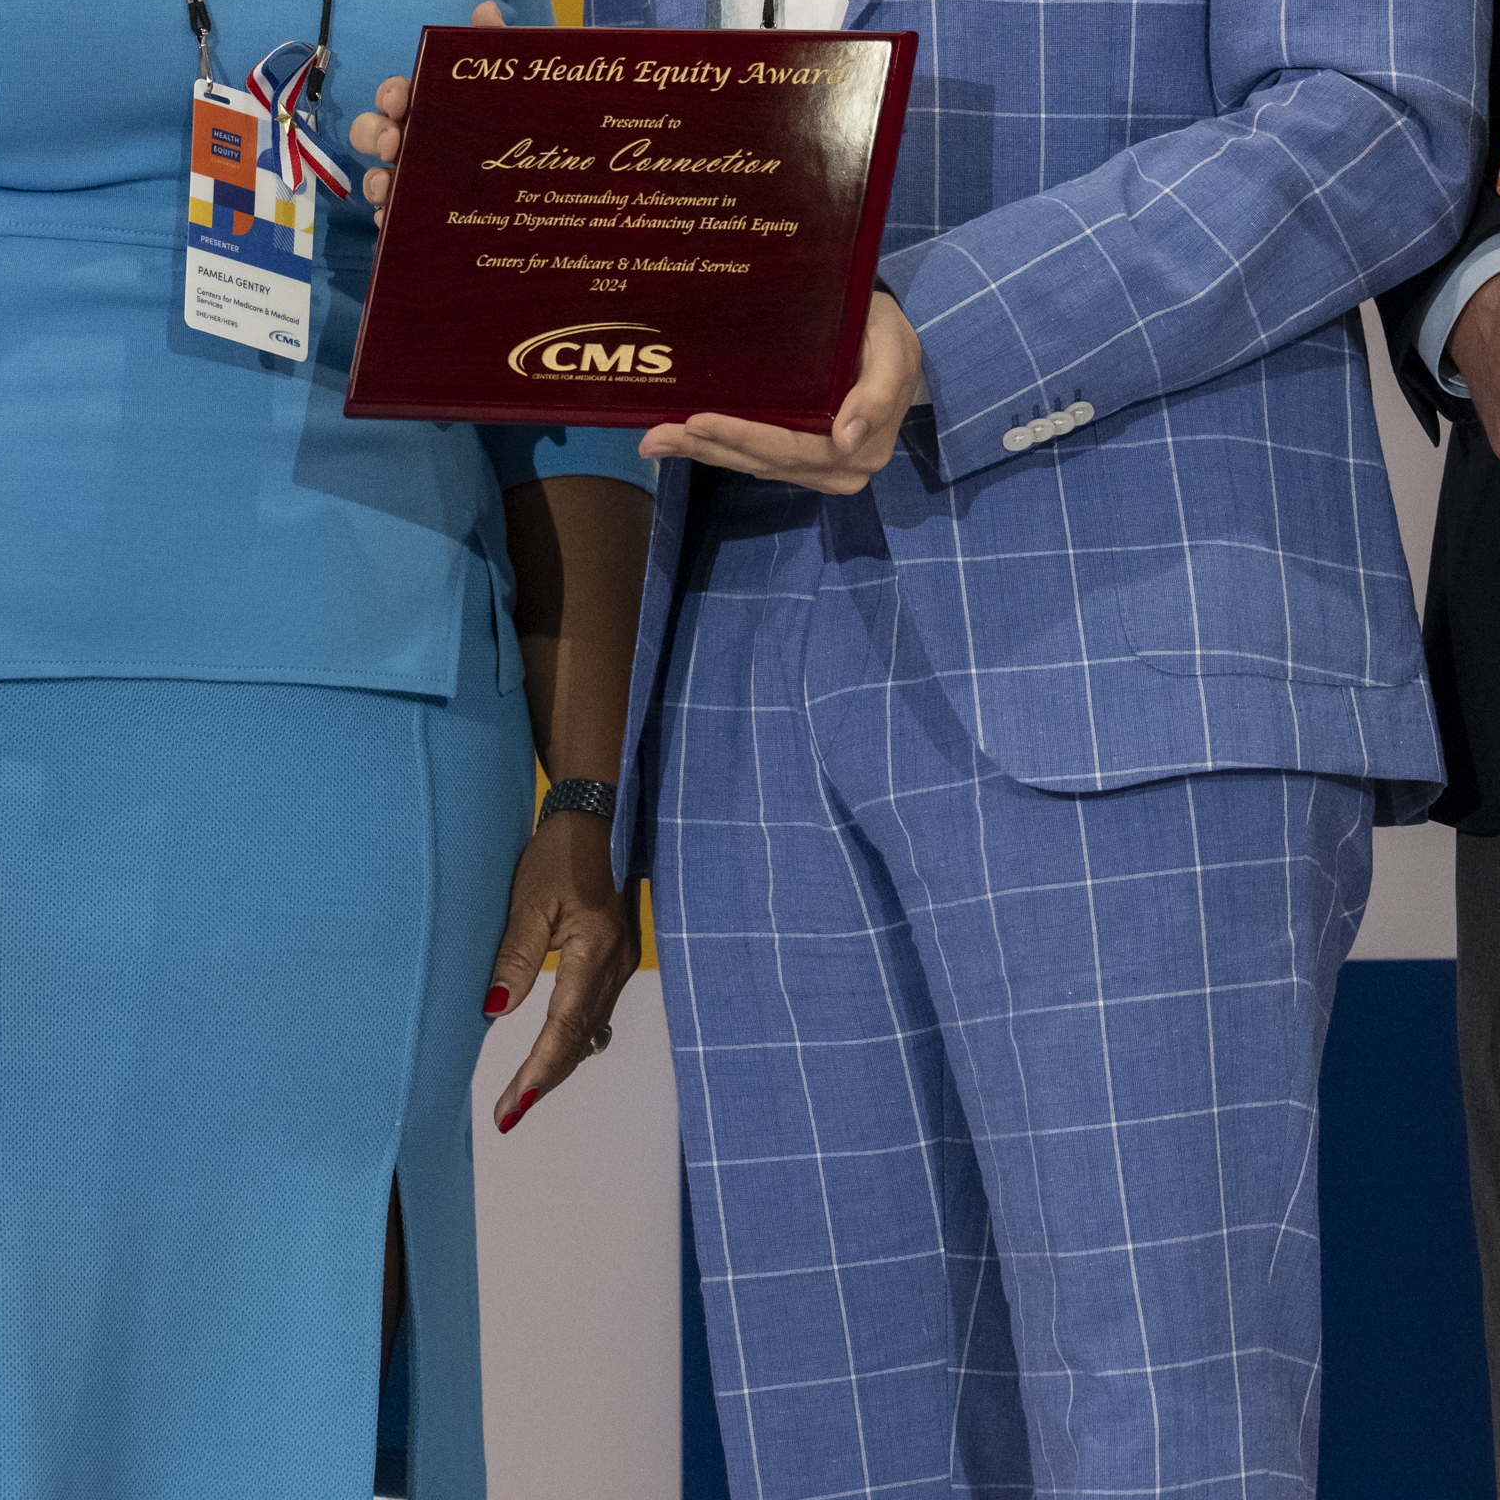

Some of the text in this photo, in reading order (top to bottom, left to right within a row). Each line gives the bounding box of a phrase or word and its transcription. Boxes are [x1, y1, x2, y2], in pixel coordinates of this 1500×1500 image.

[451, 56, 855, 92] CMS Health Equity Award
[599, 114, 681, 129] Presented to
[213, 130, 240, 144] HEALTH
[213, 145, 239, 159] EQUITY
[481, 138, 781, 174] Latino Connection
[515, 189, 737, 210] For Outstanding Achievement in
[446, 210, 799, 237] Reducing Disparities and Advancing Health Equity
[200, 235, 240, 253] PRESENTER
[476, 253, 751, 274] Centers for Medicare & Medicaid Services
[198, 266, 271, 295] PAMELA GENTRY
[589, 278, 627, 292] 2024
[196, 296, 223, 310] Services
[196, 287, 300, 325] Centers for Medicare & Medicaid
[196, 310, 238, 328] SHE/HER/HERS
[275, 333, 301, 348] CMS
[541, 341, 673, 374] CMS
[560, 373, 574, 381] FOR
[574, 374, 607, 382] MEDICARE
[614, 375, 647, 383] MEDICAID
[648, 376, 677, 384] SERVICES
